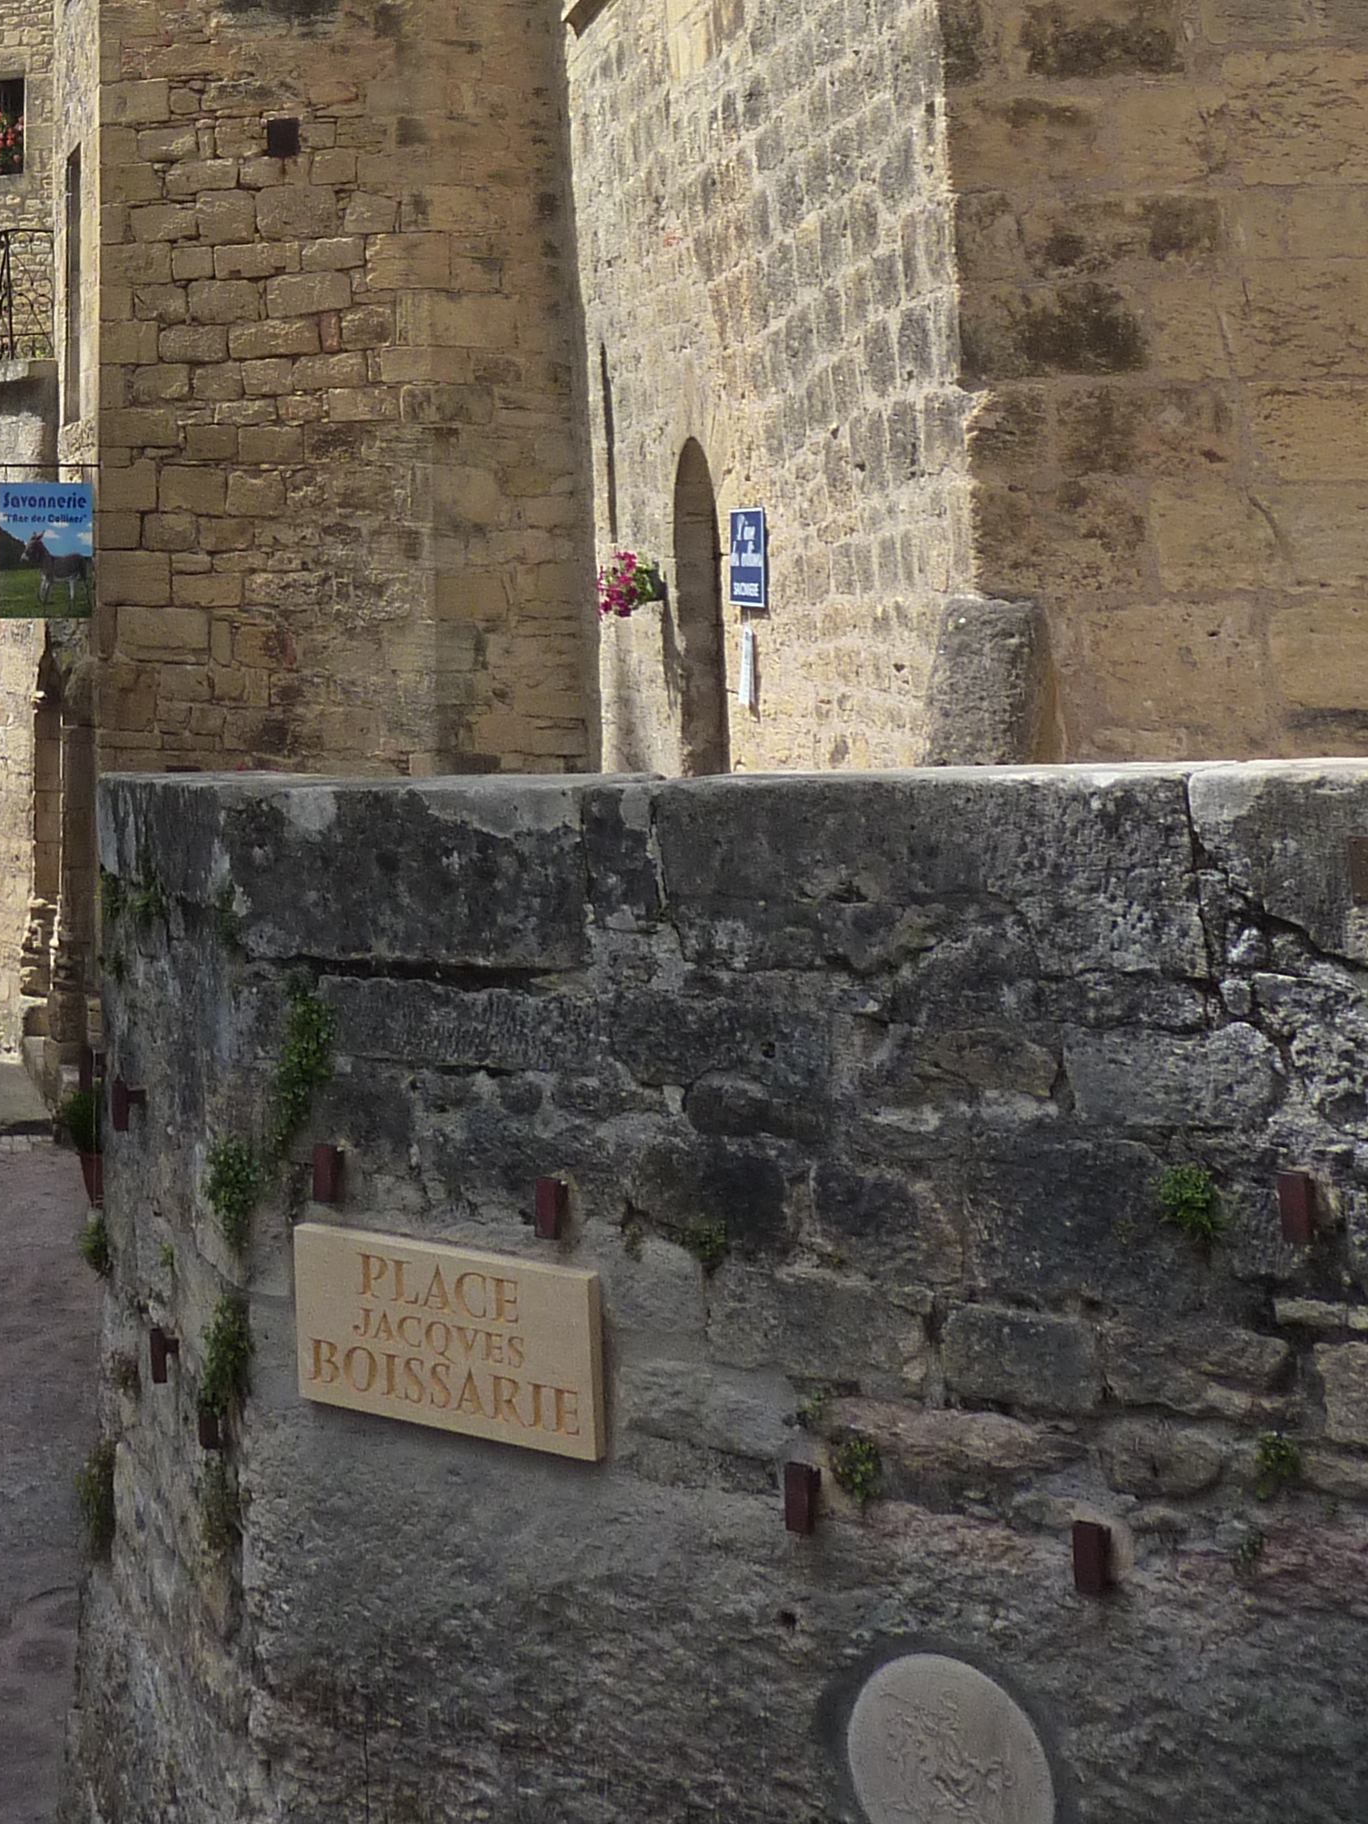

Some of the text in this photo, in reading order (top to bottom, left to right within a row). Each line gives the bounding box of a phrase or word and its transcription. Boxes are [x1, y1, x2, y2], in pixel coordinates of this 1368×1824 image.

[3, 492, 87, 509] Savonnerie
[30, 513, 46, 523] des
[356, 1251, 520, 1325] PLACE
[307, 1335, 581, 1437] BOISSARIE
